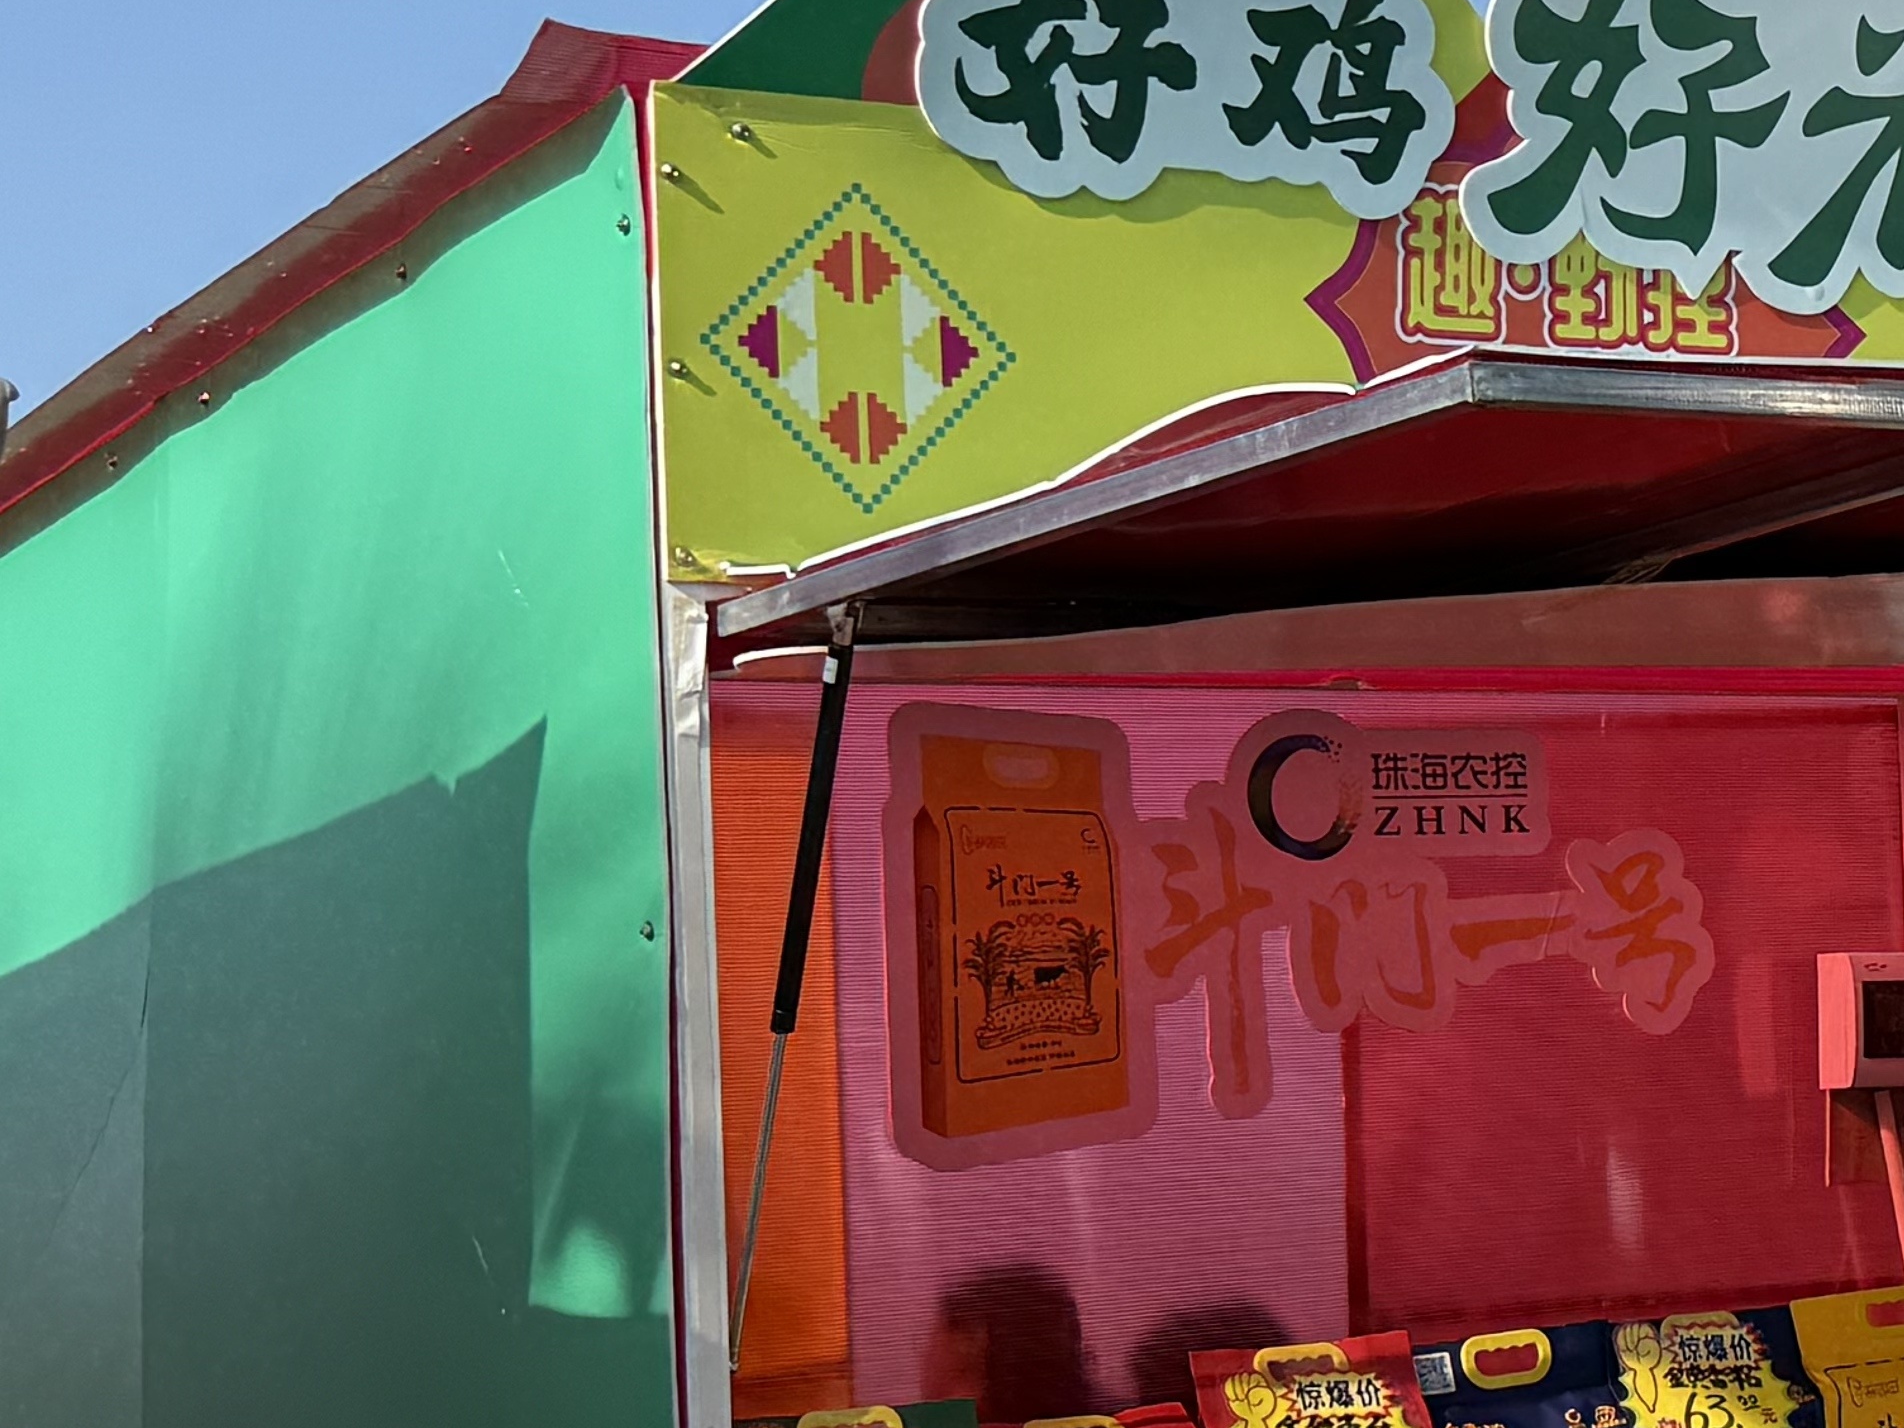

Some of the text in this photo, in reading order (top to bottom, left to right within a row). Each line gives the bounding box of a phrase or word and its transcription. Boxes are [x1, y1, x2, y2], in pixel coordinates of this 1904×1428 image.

[1371, 751, 1529, 792] 珠海农控
[1374, 803, 1530, 837] ZHNK
[986, 863, 1081, 908] 斗门一号
[1145, 805, 1692, 1094] 斗门一号
[1679, 1334, 1751, 1362] 惊爆价
[1297, 1378, 1380, 1410] 惊爆价
